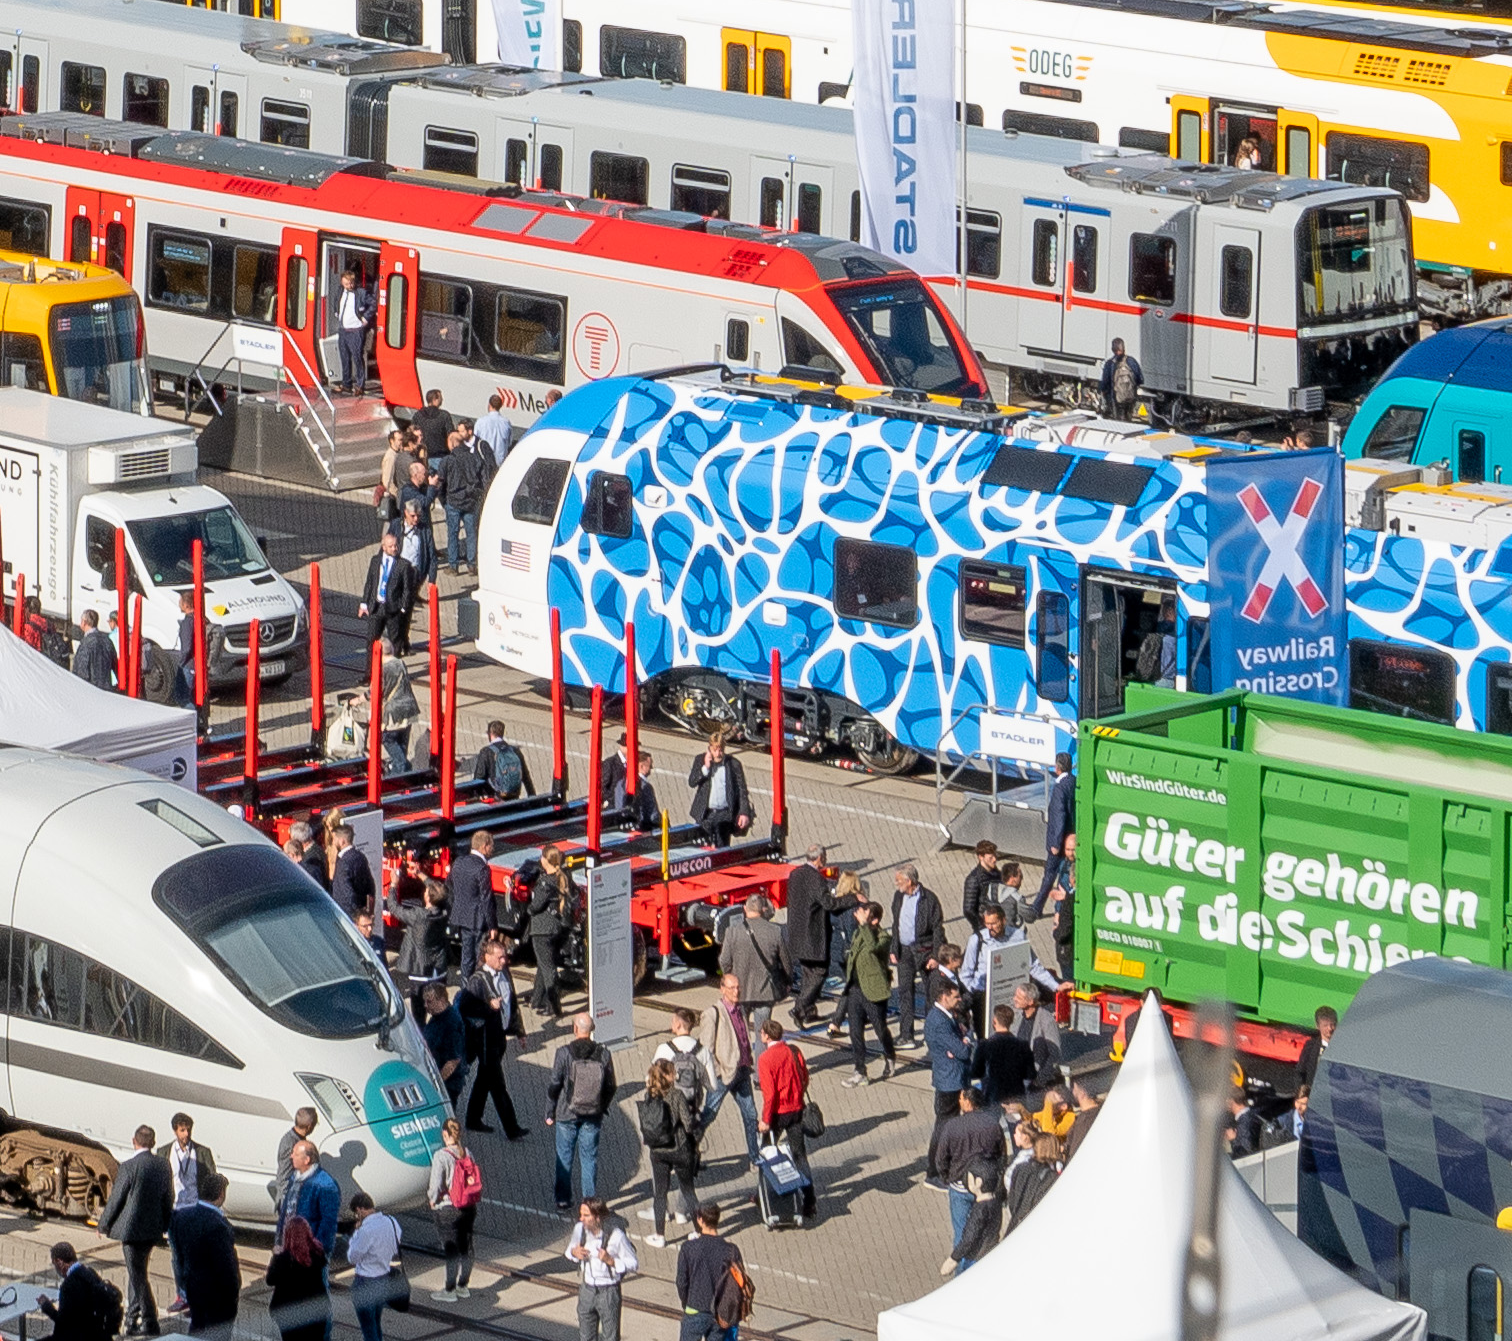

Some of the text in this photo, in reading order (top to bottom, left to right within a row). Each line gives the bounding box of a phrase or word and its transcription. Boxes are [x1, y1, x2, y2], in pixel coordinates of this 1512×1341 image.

[1029, 49, 1072, 78] ODEG
[239, 338, 276, 352] STADLER
[48, 462, 60, 601] Kühlfahrzeuge
[226, 593, 286, 611] ALLROUND
[991, 730, 1045, 746] STADLER
[1105, 769, 1227, 805] WirSindGüter.de
[669, 856, 712, 876] wecon
[1104, 811, 1479, 930] Güter gehören
[1104, 884, 1473, 973] auf die Schien
[390, 1114, 441, 1139] SIEMENS
